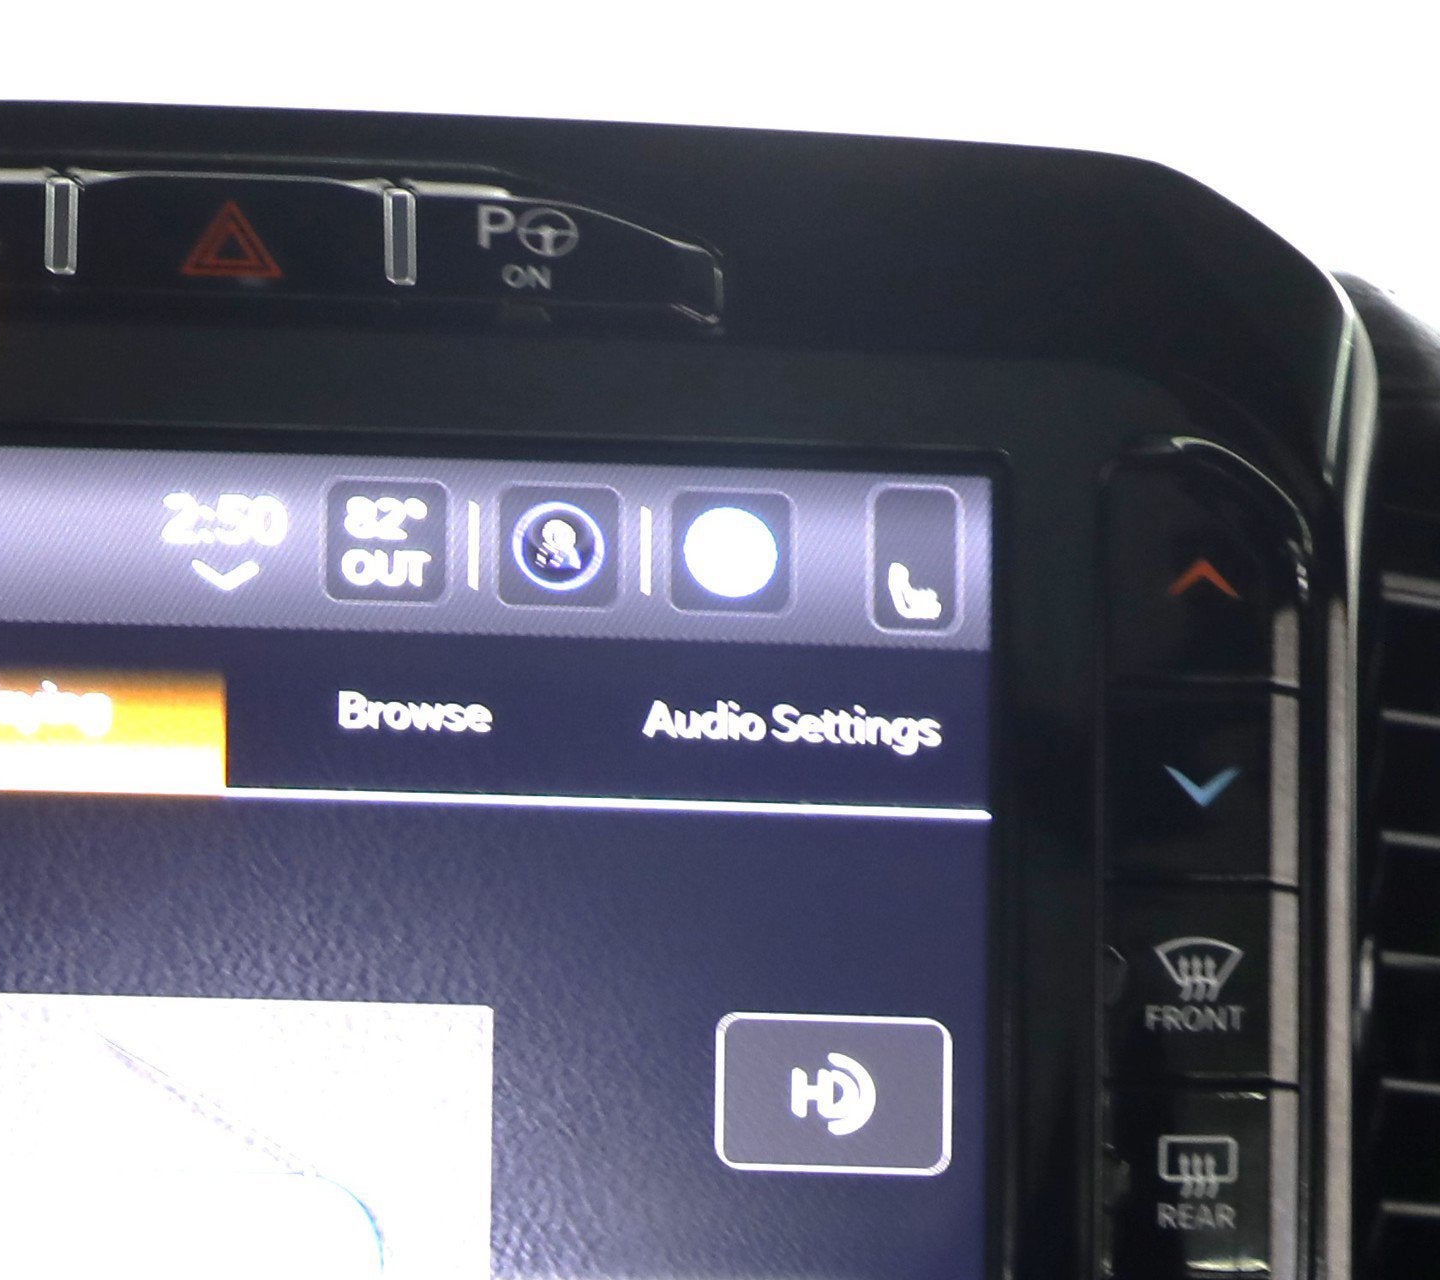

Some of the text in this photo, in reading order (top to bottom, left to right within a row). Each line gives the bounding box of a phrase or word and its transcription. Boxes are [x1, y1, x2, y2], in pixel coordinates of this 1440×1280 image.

[503, 263, 553, 291] ON
[162, 493, 289, 546] 2:50
[341, 549, 431, 588] OUT
[338, 690, 493, 734] Browse
[642, 699, 941, 754] Audio Settings
[1145, 1004, 1245, 1032] FRONT
[1156, 1202, 1237, 1230] REAR
